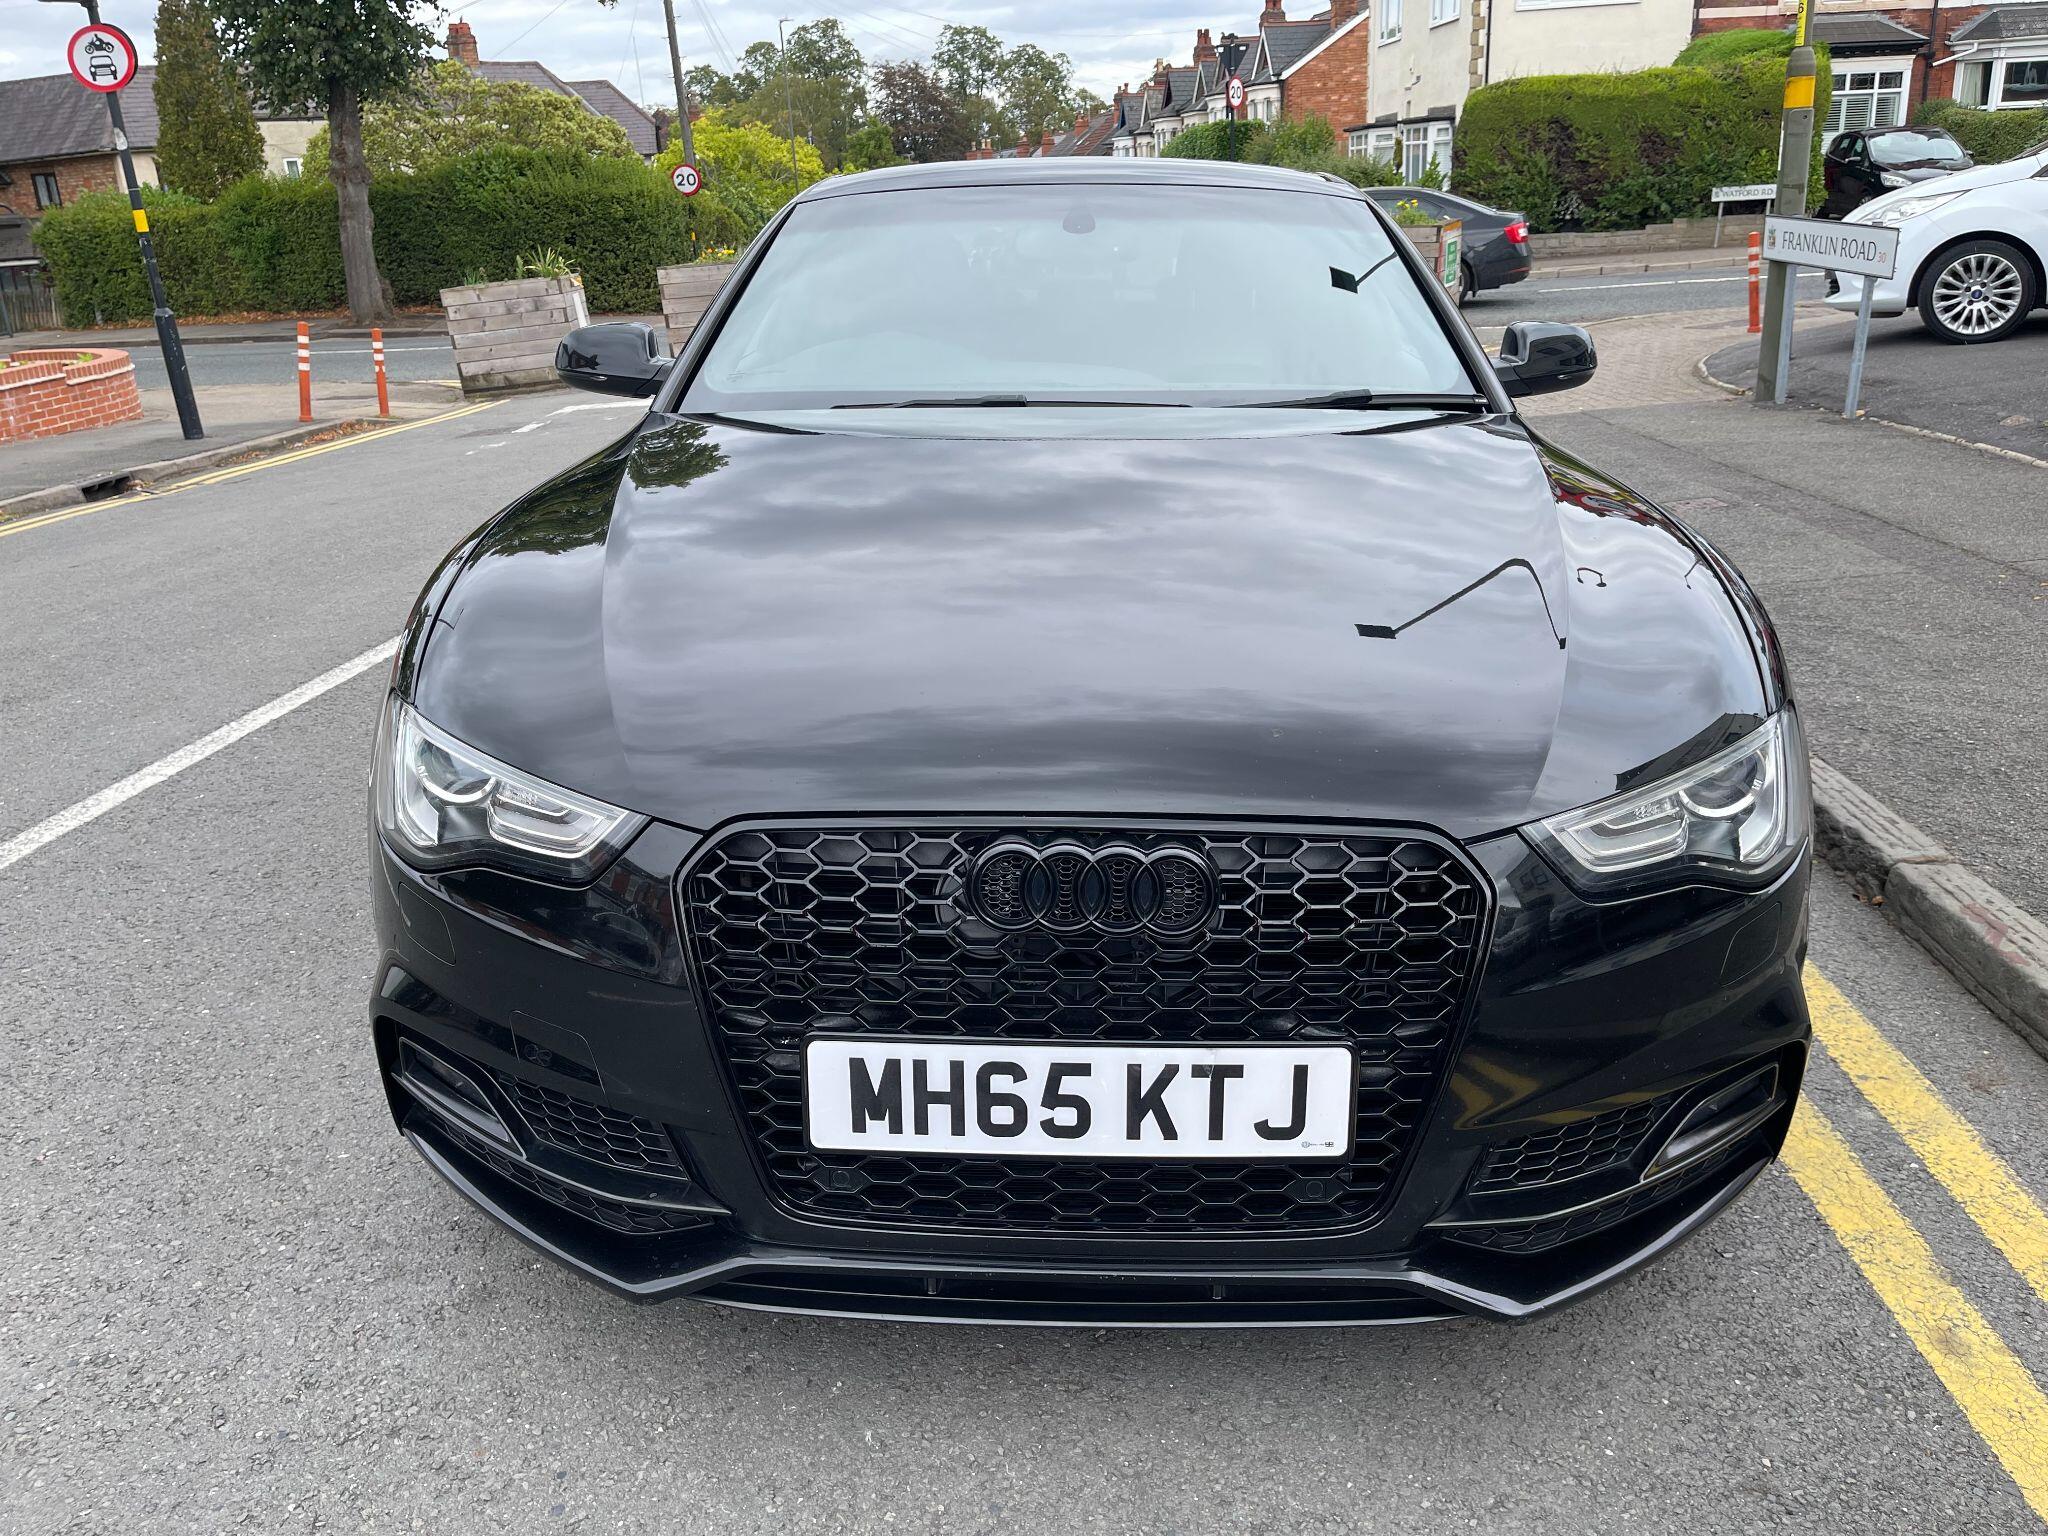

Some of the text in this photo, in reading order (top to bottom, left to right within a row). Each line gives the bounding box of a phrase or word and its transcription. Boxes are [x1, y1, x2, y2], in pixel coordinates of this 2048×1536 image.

[1798, 2, 1804, 14] 6
[1231, 86, 1242, 99] 20
[675, 173, 697, 187] 20
[1722, 187, 1774, 198] WATFORD RD
[1781, 231, 1887, 264] FRANKLIN ROAD 30
[848, 1056, 1310, 1142] MH65 KTJ
